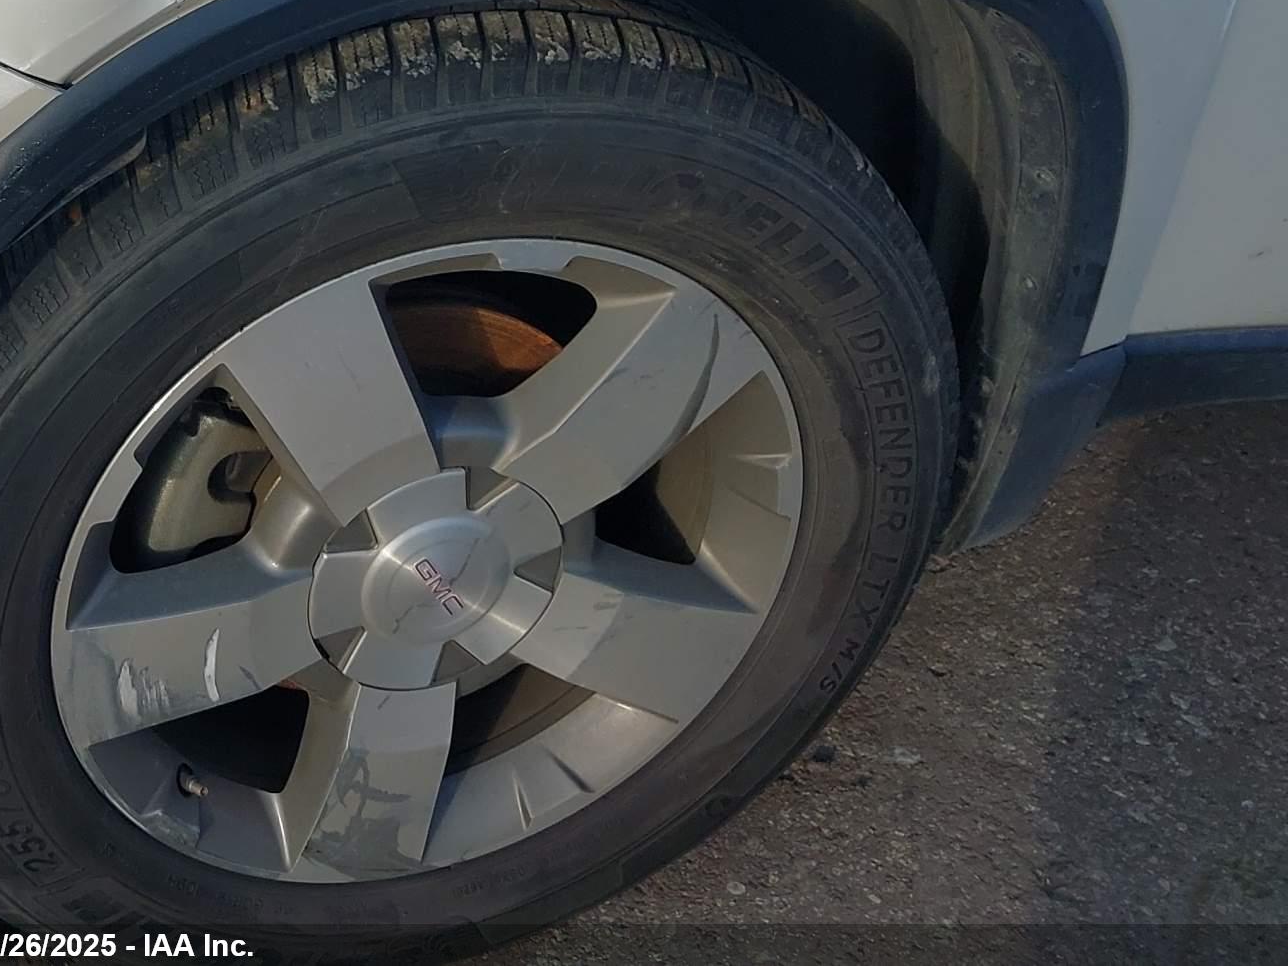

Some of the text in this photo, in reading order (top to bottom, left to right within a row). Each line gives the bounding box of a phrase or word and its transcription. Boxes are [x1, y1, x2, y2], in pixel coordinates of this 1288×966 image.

[413, 557, 465, 617] GMC
[819, 327, 911, 694] DEFENDER LTX M/S
